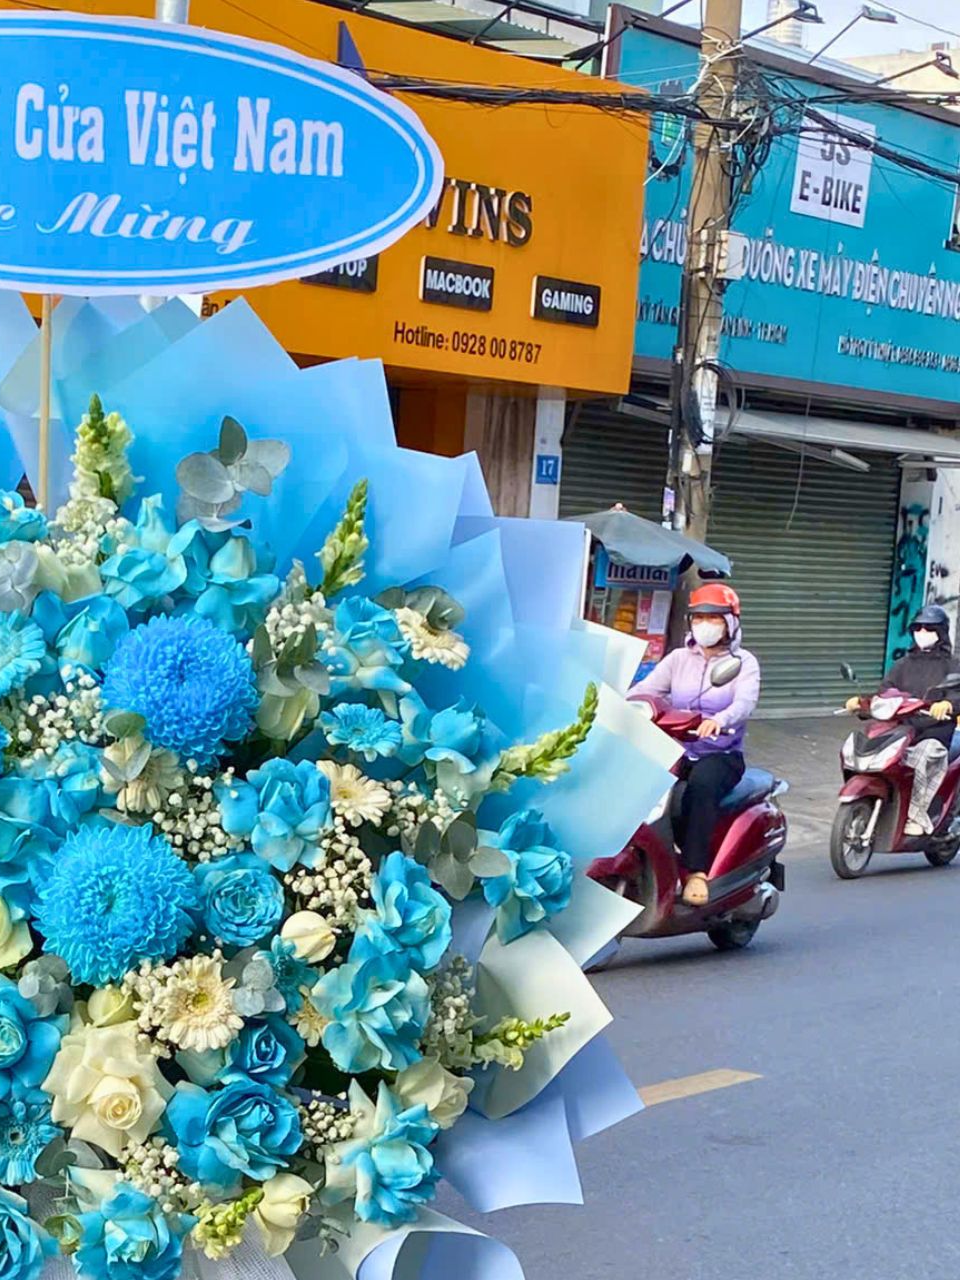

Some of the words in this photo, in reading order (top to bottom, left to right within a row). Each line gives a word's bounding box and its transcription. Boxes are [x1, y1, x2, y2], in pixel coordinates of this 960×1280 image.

[14, 82, 105, 163] Cửa
[124, 90, 217, 185] Việt
[233, 97, 344, 178] Nam
[35, 191, 257, 254] Mừng
[426, 269, 490, 299] MACBOOK
[541, 288, 594, 316] GAMING
[795, 249, 818, 291] XE
[852, 248, 890, 316] ĐIỆN
[393, 320, 449, 351] Hotline:
[451, 330, 486, 357] 0928
[489, 337, 507, 360] 00
[509, 340, 542, 365] 8787
[542, 459, 555, 476] 17
